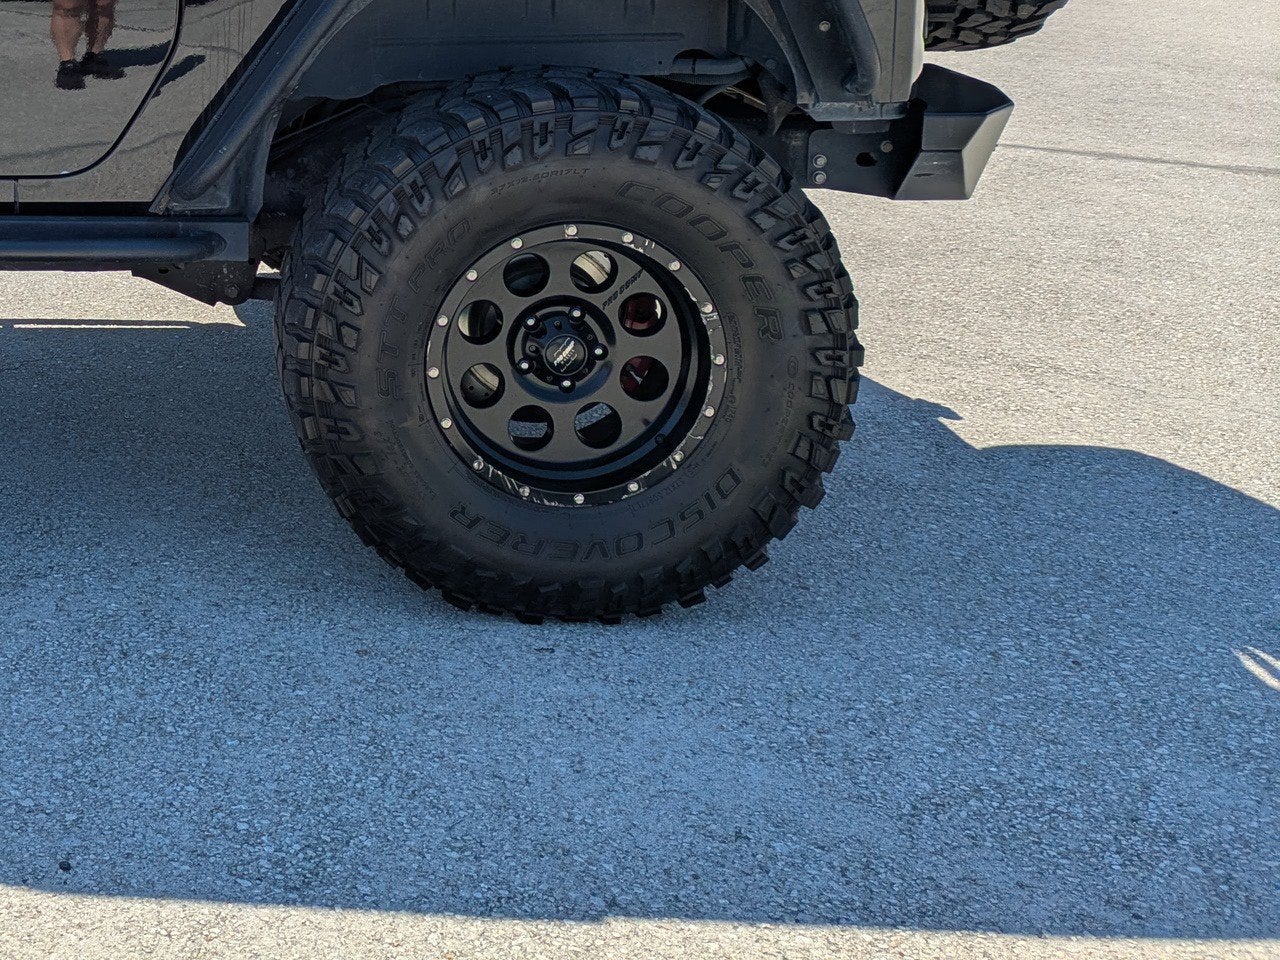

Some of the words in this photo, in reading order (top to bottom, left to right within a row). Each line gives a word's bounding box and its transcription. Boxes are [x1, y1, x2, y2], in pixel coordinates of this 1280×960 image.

[602, 292, 619, 310] PRO
[615, 181, 784, 342] COOPER
[448, 465, 742, 564] DISCOVERER
